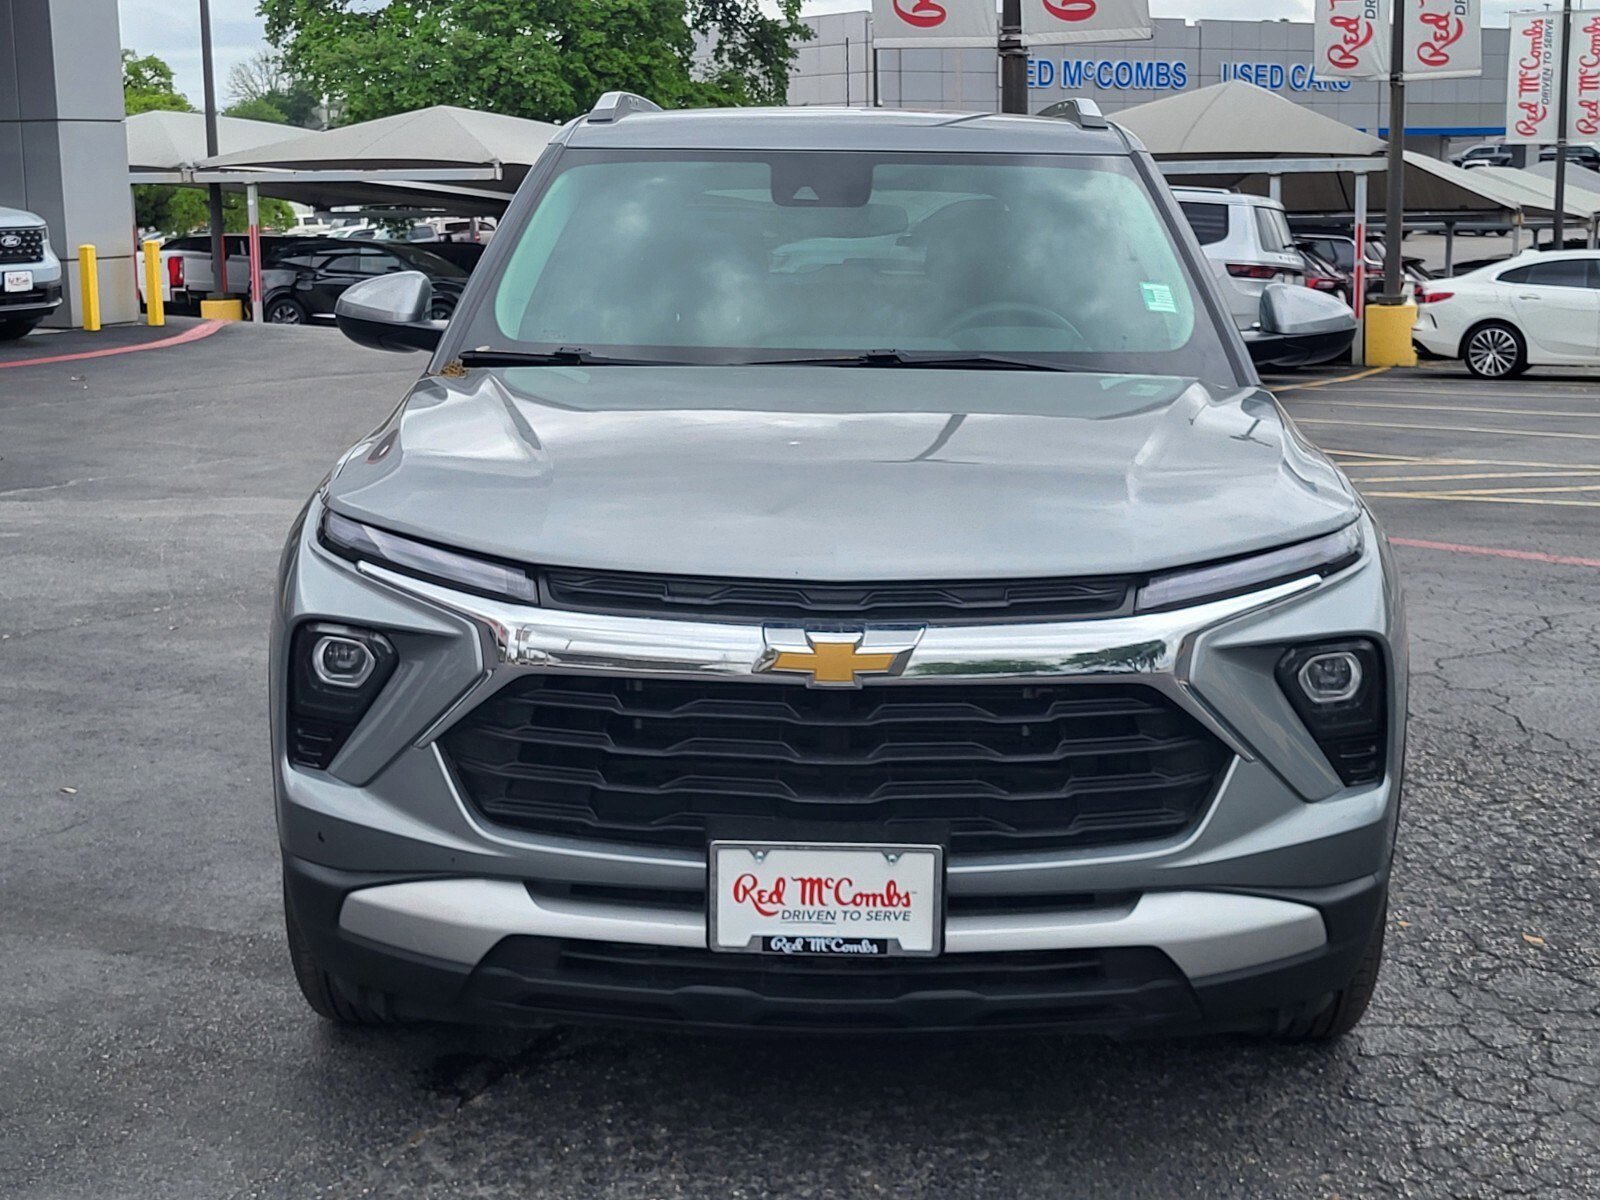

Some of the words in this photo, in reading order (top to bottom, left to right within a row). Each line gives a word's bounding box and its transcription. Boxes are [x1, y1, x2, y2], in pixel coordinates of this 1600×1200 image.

[1327, 15, 1373, 69] Red
[1417, 12, 1464, 67] Red
[1544, 18, 1554, 49] SERVE
[1519, 19, 1543, 98] McCombs
[1543, 51, 1552, 64] TO
[1222, 62, 1285, 90] USED
[1541, 67, 1553, 105] DRIVEN
[1515, 102, 1547, 136] Red
[733, 873, 786, 916] Red
[791, 876, 911, 908] McCombs
[781, 909, 836, 922] DRIVEN
[842, 910, 861, 922] TO
[866, 910, 911, 922] SERVE
[770, 936, 803, 954] Red
[804, 937, 878, 954] McCombs
